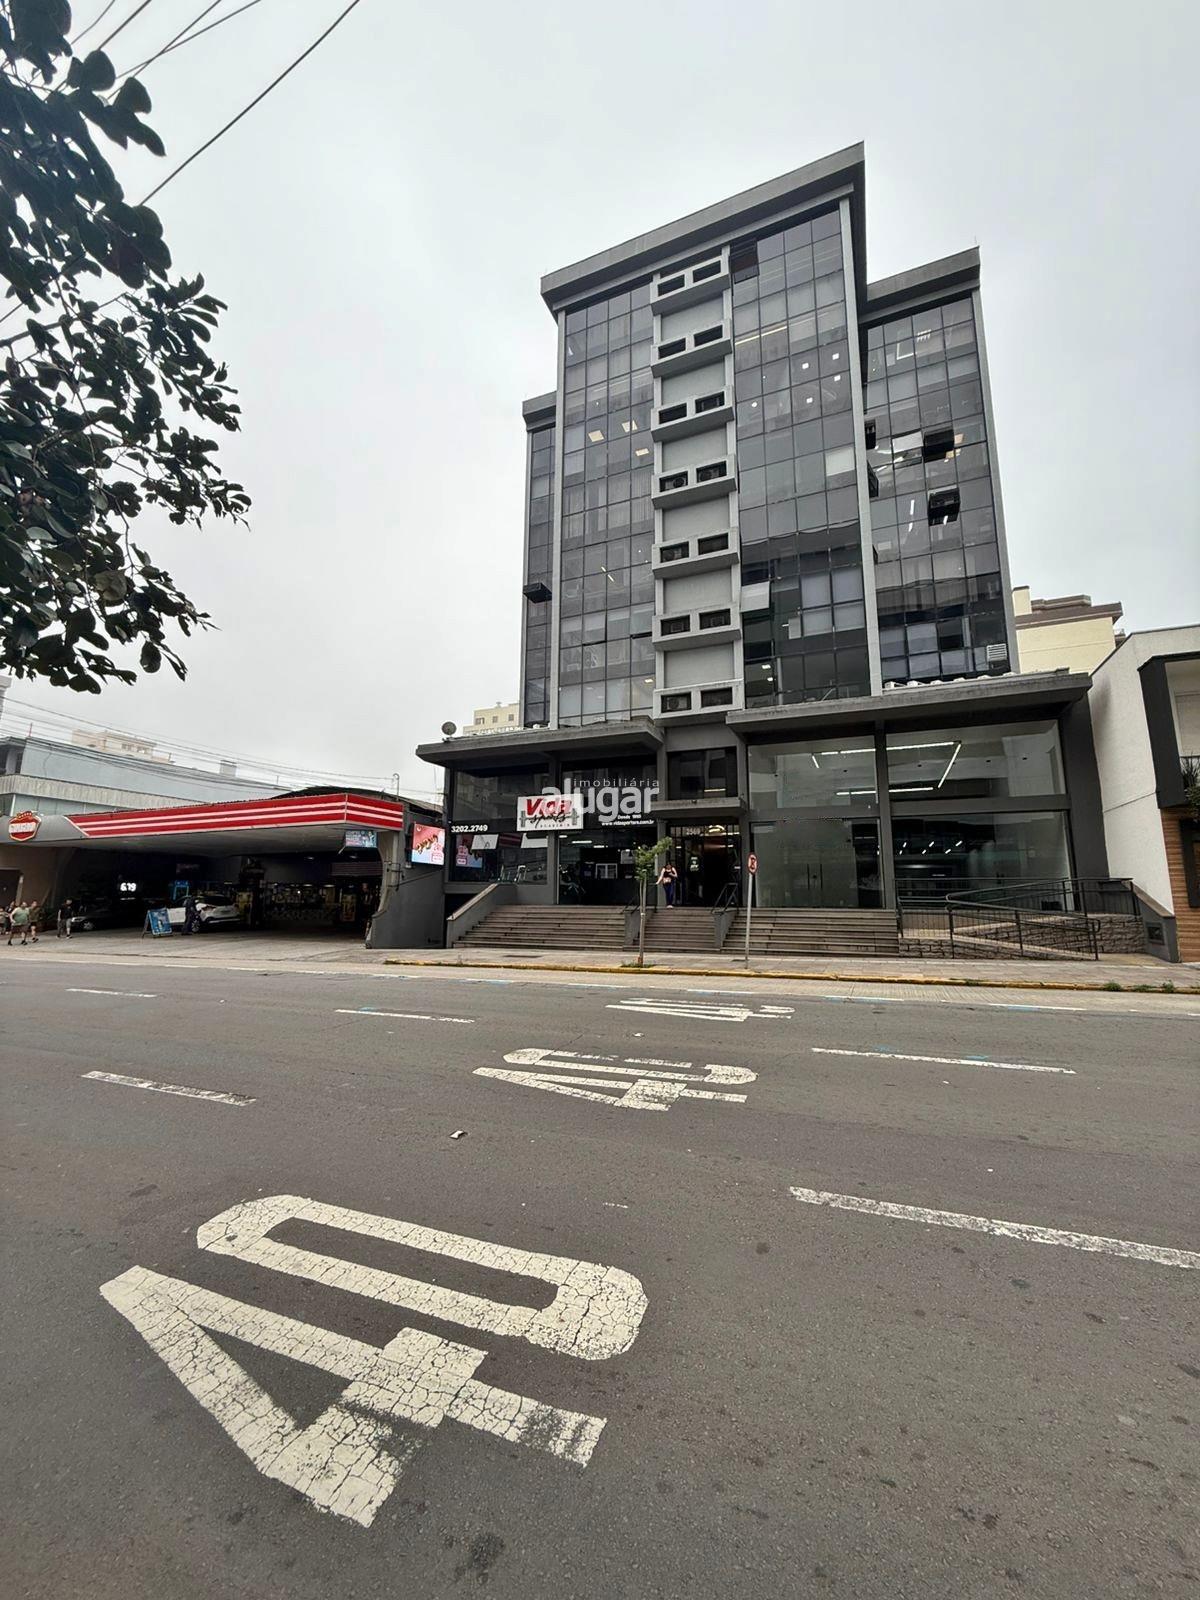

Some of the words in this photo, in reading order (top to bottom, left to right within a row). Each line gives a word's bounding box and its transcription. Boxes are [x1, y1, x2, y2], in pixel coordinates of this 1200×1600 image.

[450, 824, 489, 833] 3202.2749
[472, 1047, 758, 1111] 40
[99, 1195, 648, 1528] 40
